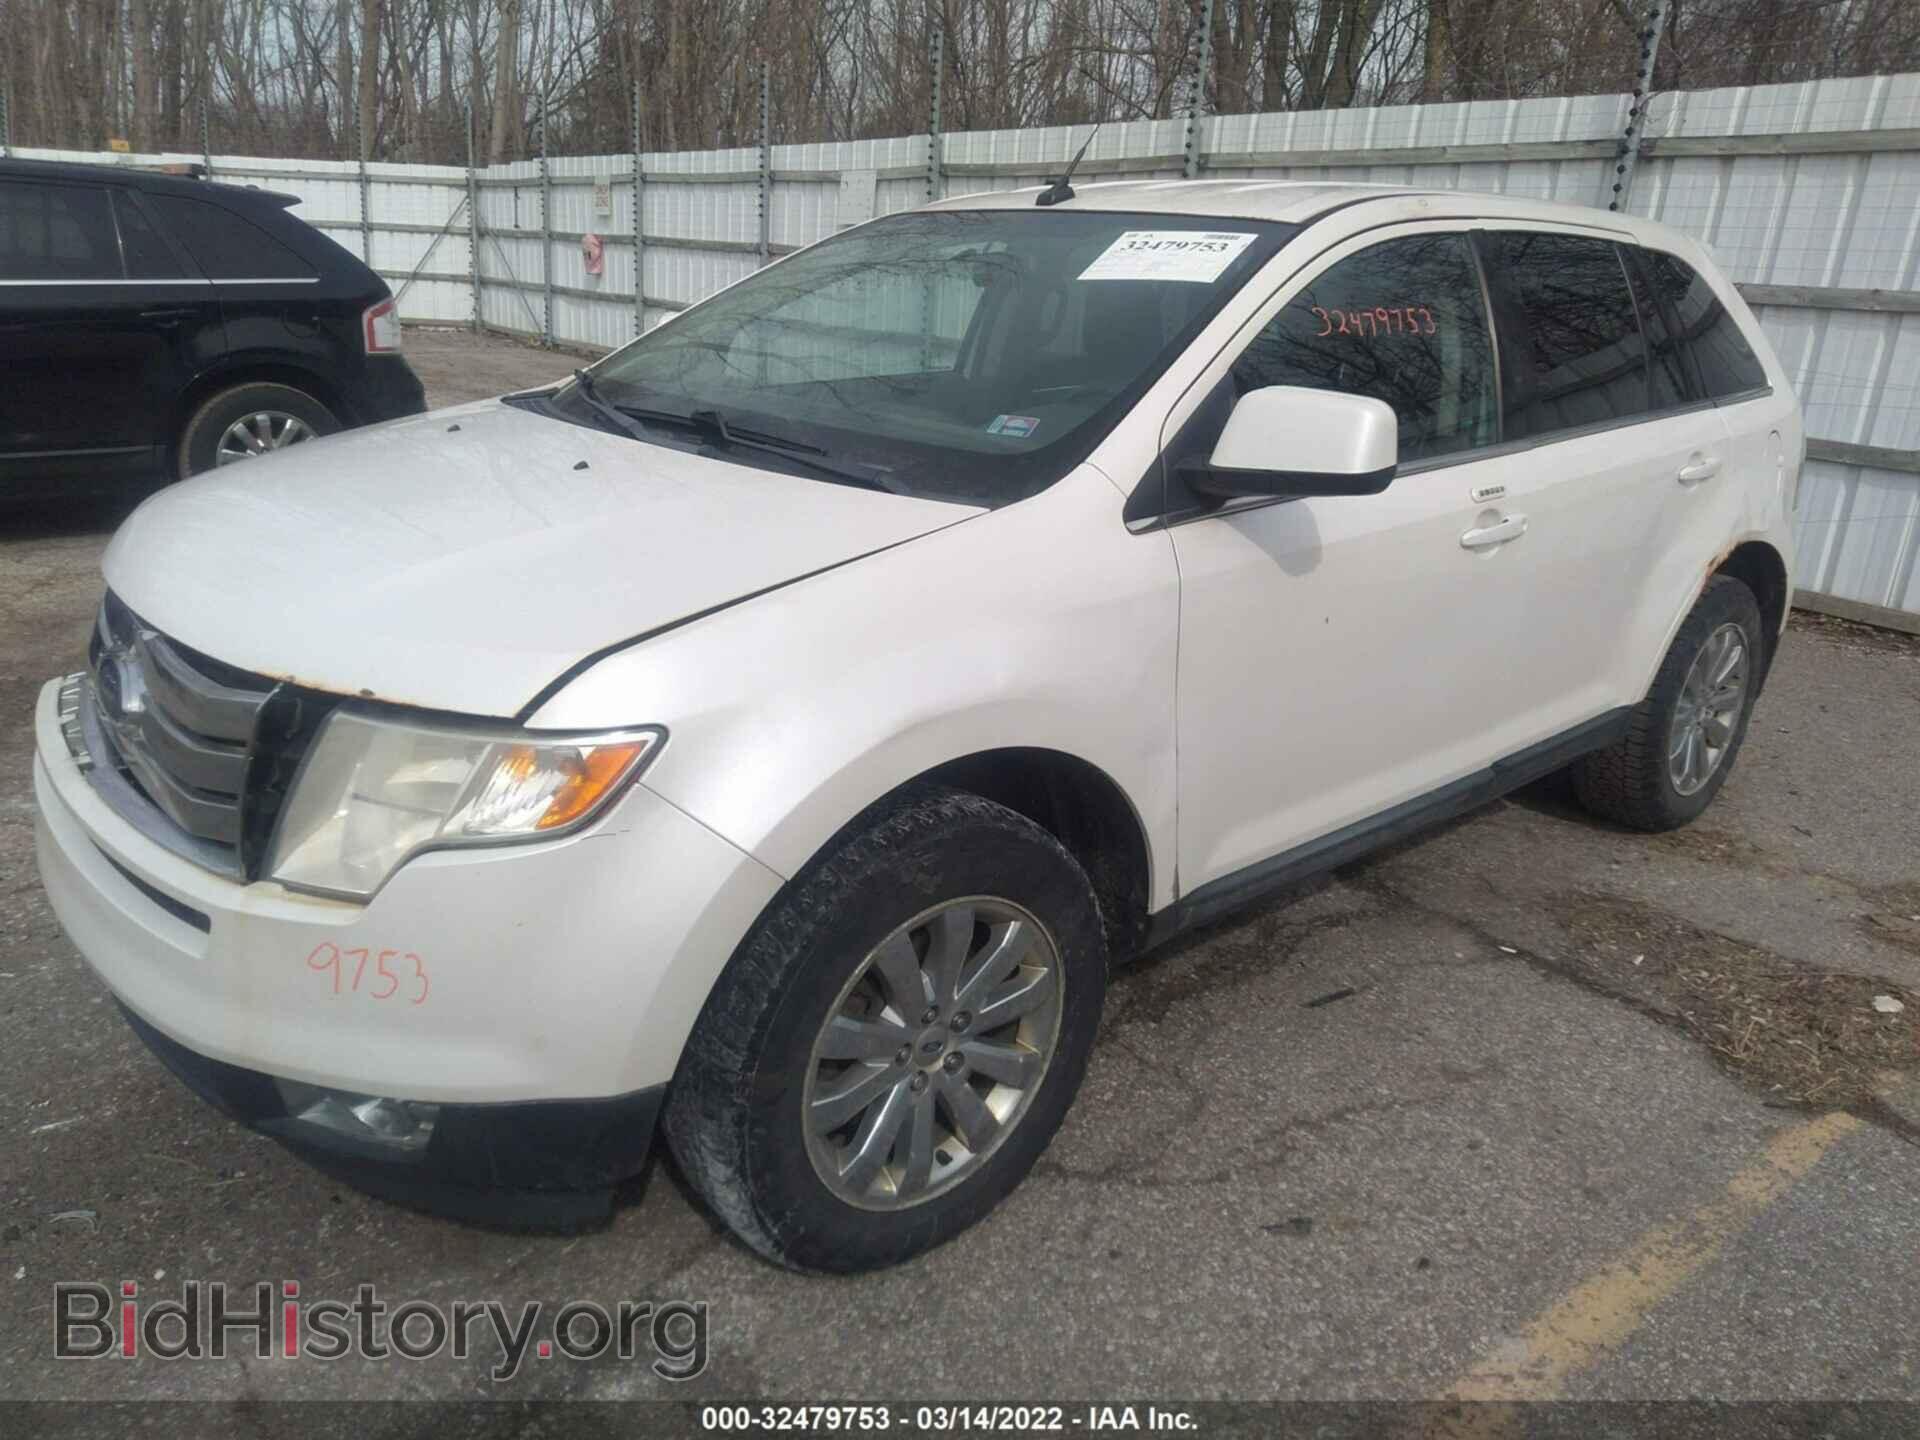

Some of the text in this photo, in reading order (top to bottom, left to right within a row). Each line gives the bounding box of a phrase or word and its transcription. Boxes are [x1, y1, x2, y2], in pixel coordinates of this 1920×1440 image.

[1122, 239, 1230, 253] 32479753
[1311, 306, 1436, 337] 32479753
[307, 942, 429, 1004] 9753
